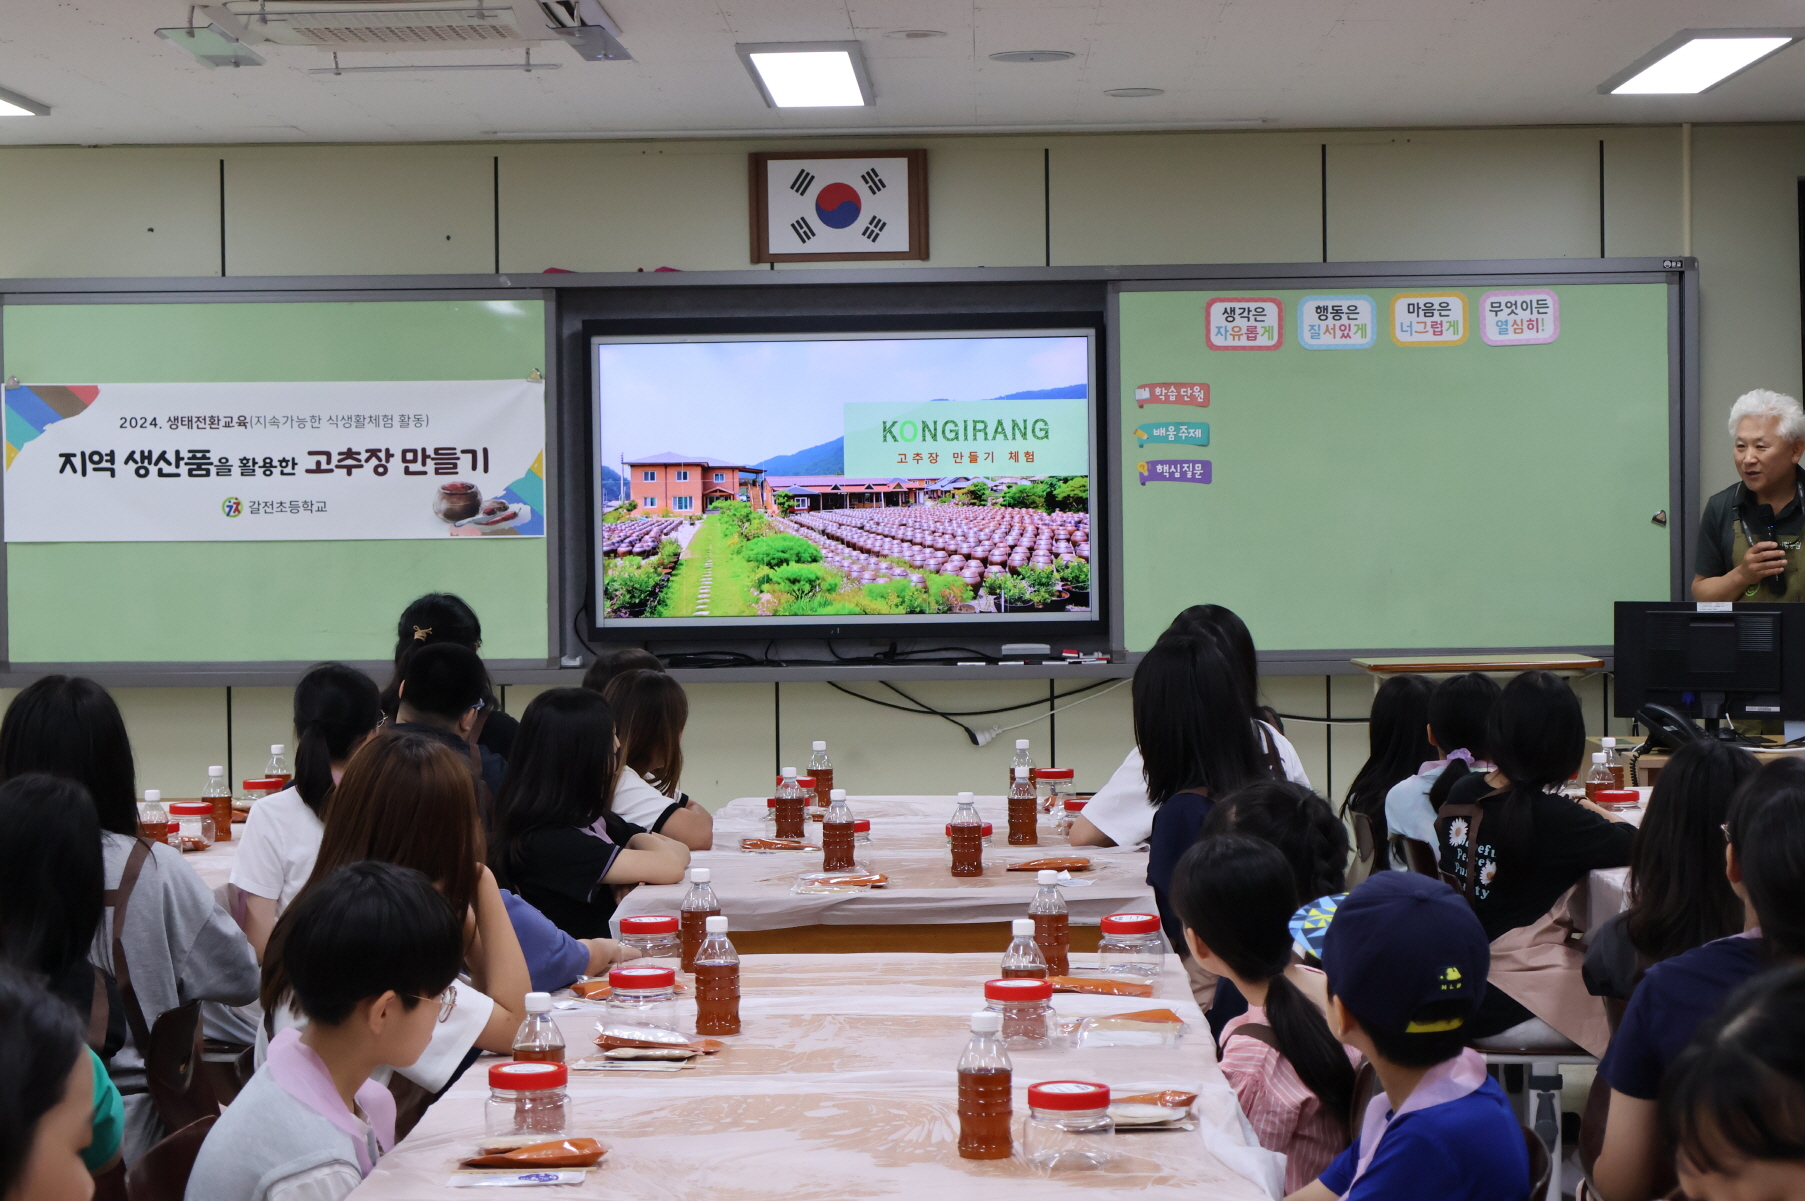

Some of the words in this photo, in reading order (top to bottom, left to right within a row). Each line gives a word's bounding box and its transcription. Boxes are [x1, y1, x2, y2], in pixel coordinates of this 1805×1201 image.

[1222, 306, 1267, 323] 생각은
[1315, 304, 1360, 322] 행동은
[1407, 301, 1452, 318] 마음은
[1488, 299, 1550, 317] 무엇이든
[1215, 325, 1274, 341] 자유롭게
[1308, 323, 1367, 340] 질서있게
[1400, 320, 1459, 337] 너그럽게
[1495, 318, 1545, 336] 열심히!
[1154, 385, 1178, 401] 학습
[1180, 386, 1204, 402] 단원
[119, 416, 163, 429] 2024.
[326, 414, 394, 429] 식생활체험
[398, 414, 430, 429] 활동)
[882, 418, 1050, 443] KONGIRANG
[1153, 426, 1177, 441] 배움
[1178, 426, 1202, 440] 주제
[58, 449, 116, 478] 지역
[124, 449, 234, 478] 생산품을
[238, 456, 298, 477] 활용한
[304, 447, 395, 477] 고추장
[401, 447, 489, 476] 만들기
[896, 451, 940, 464] 고추장
[952, 451, 995, 464] 만들기
[1008, 450, 1036, 463] 체험
[1156, 463, 1180, 478] 핵심
[1182, 463, 1204, 478] 질문
[248, 500, 328, 515] 갈전초등학교
